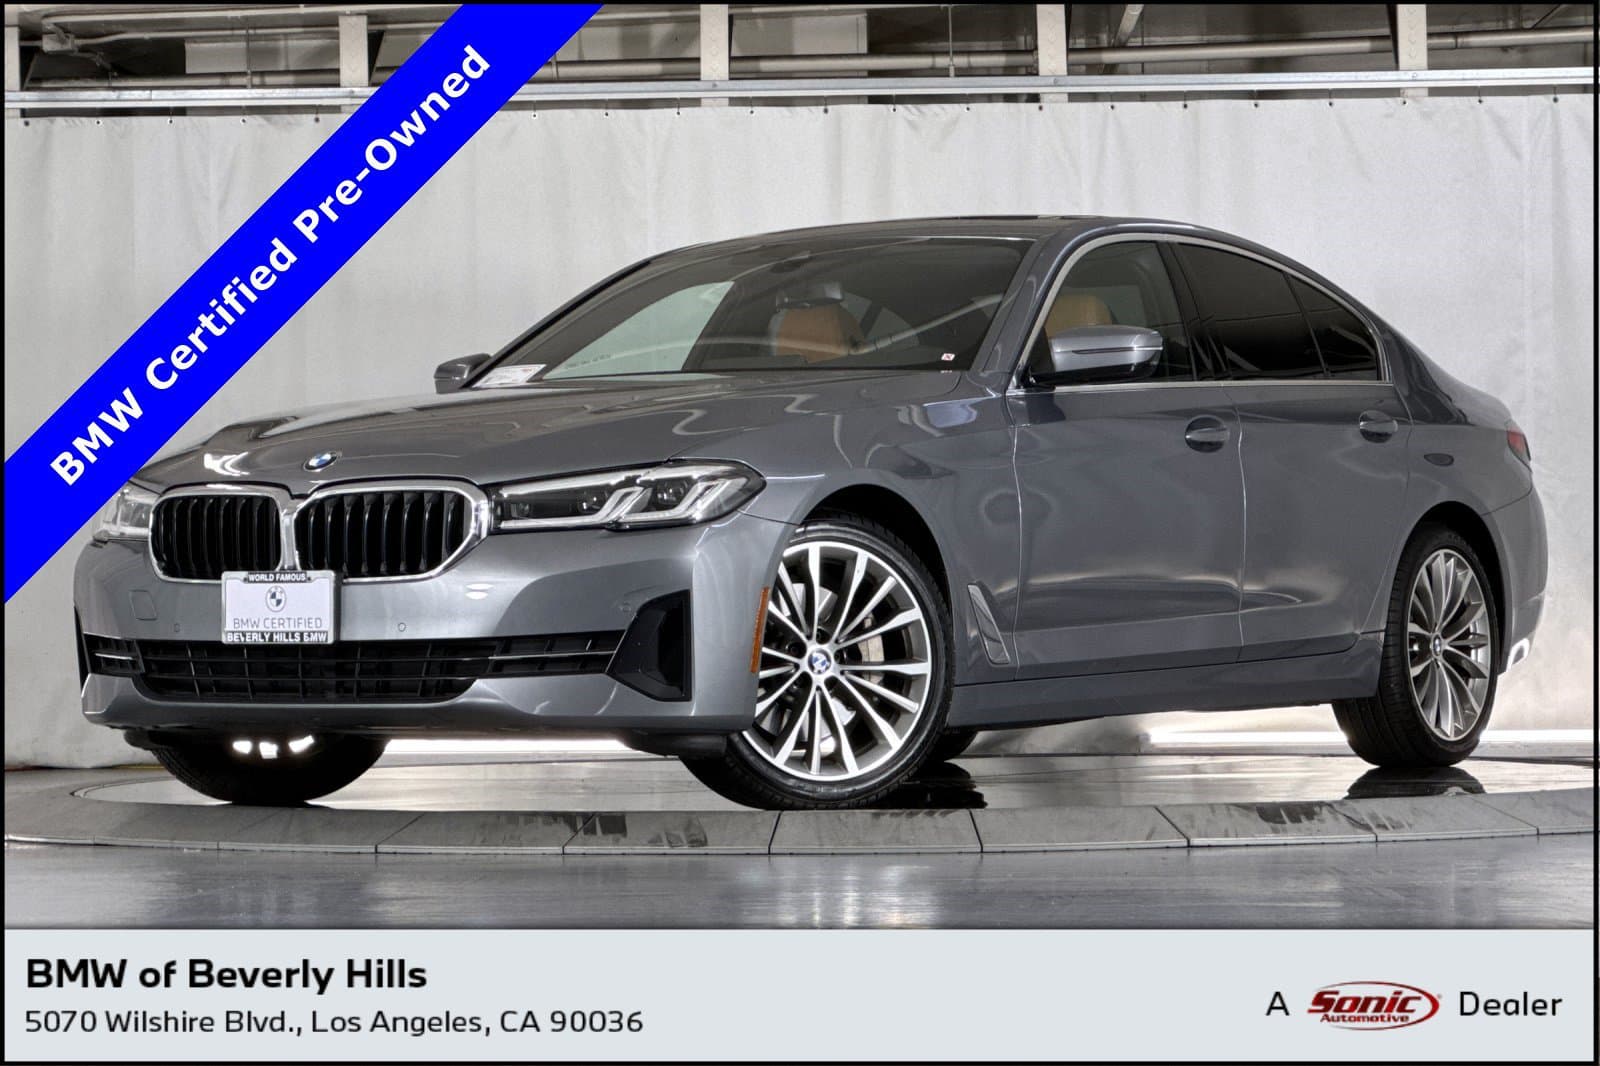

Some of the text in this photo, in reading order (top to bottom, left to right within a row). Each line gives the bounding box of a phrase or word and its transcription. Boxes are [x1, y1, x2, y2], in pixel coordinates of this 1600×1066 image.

[248, 573, 306, 582] WORLD FAMOUS
[233, 617, 323, 630] BMW CERTIFIED
[227, 632, 271, 642] BEVERLY
[273, 632, 300, 642] HILLS
